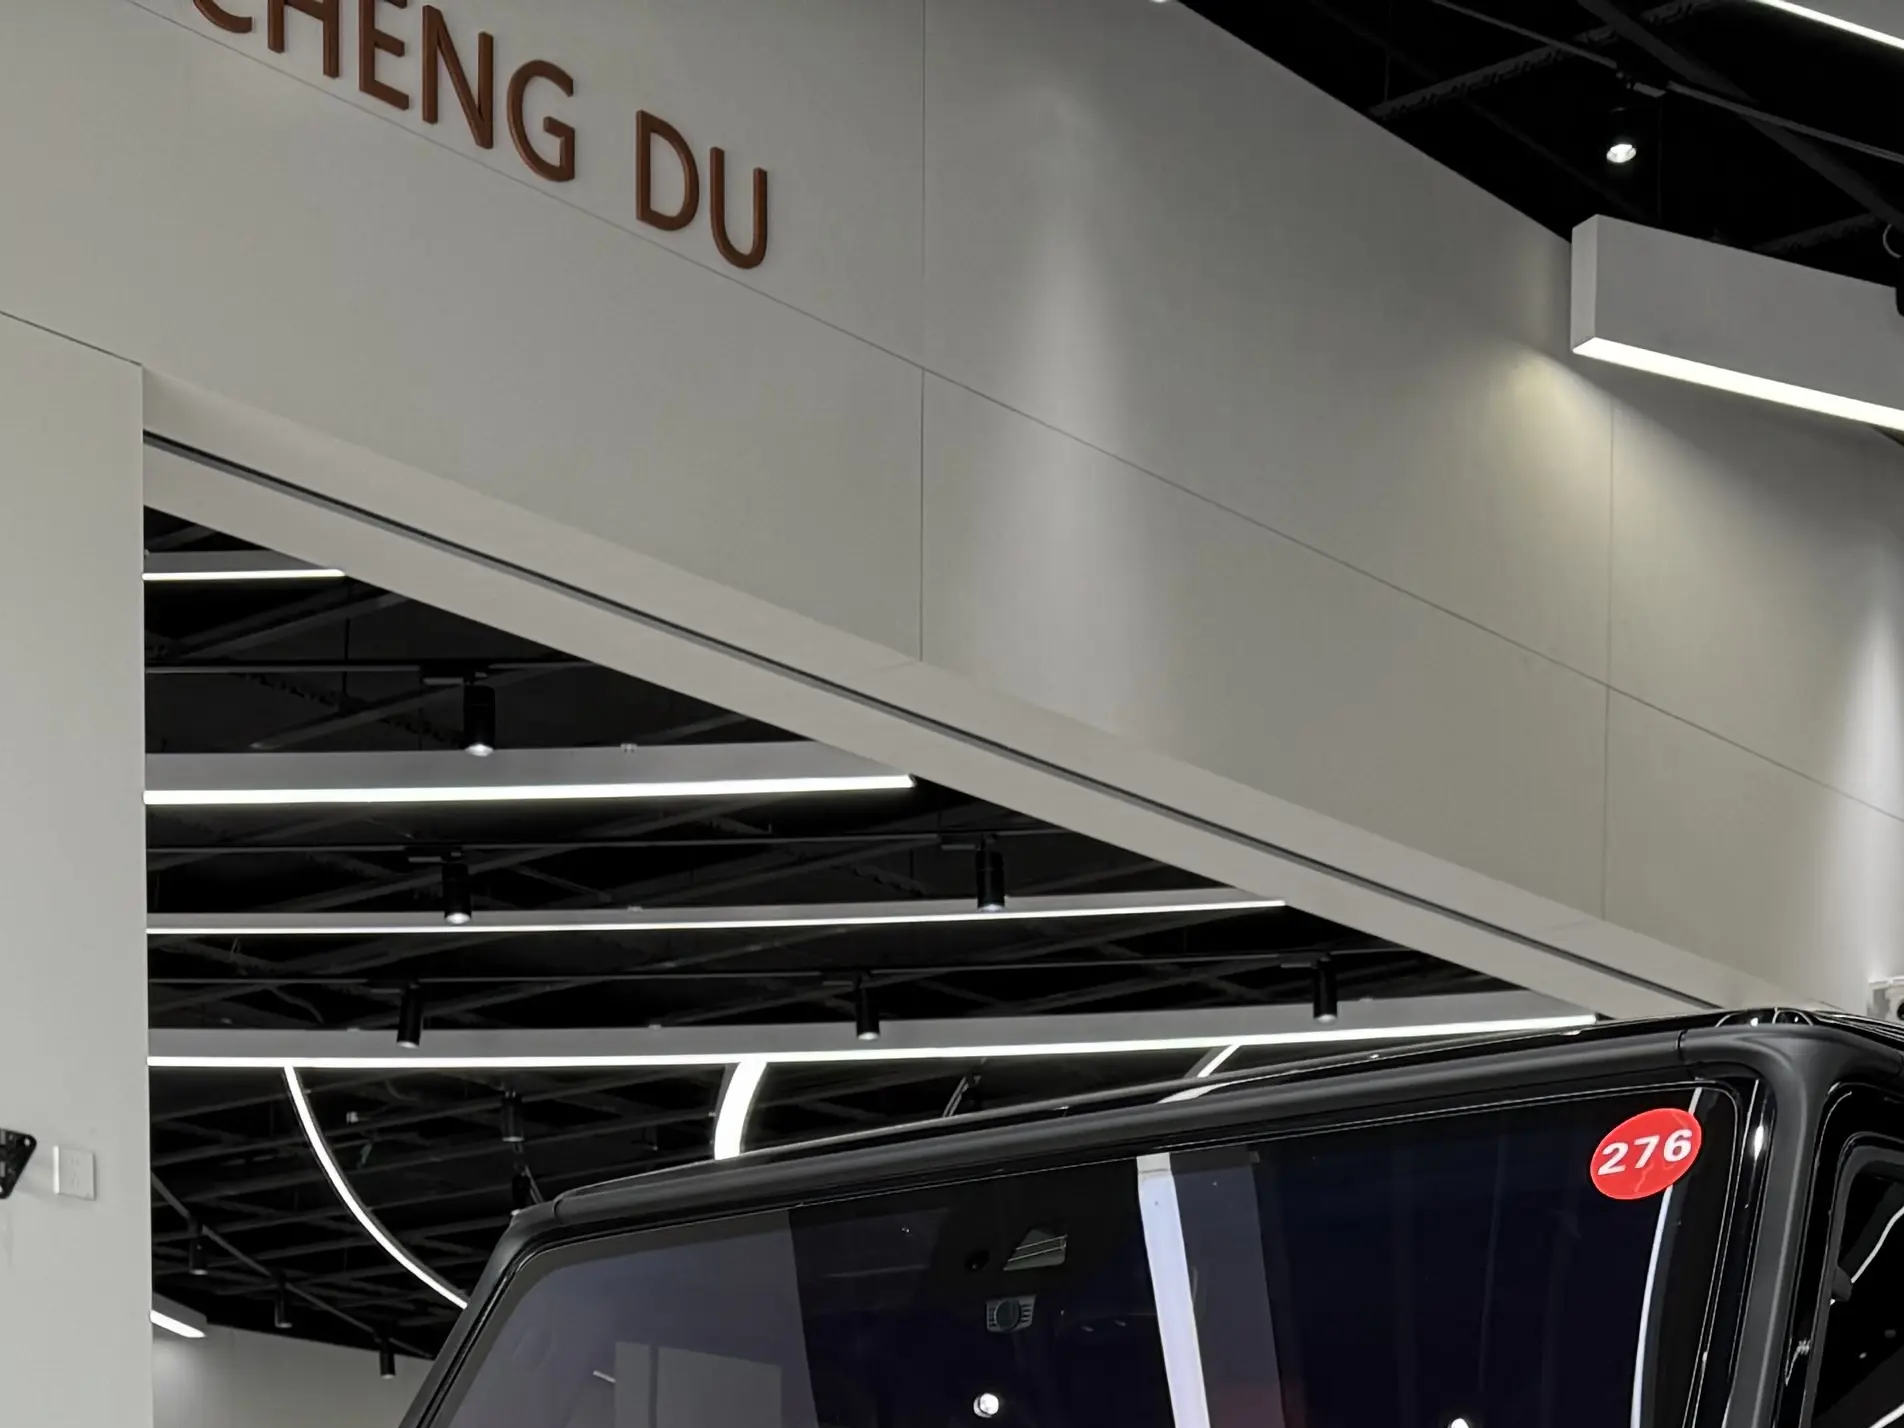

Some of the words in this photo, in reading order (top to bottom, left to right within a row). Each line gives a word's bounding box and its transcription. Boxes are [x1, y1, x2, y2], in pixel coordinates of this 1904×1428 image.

[192, 0, 576, 183] HENG
[636, 110, 768, 270] DU
[1597, 1128, 1693, 1176] 276
